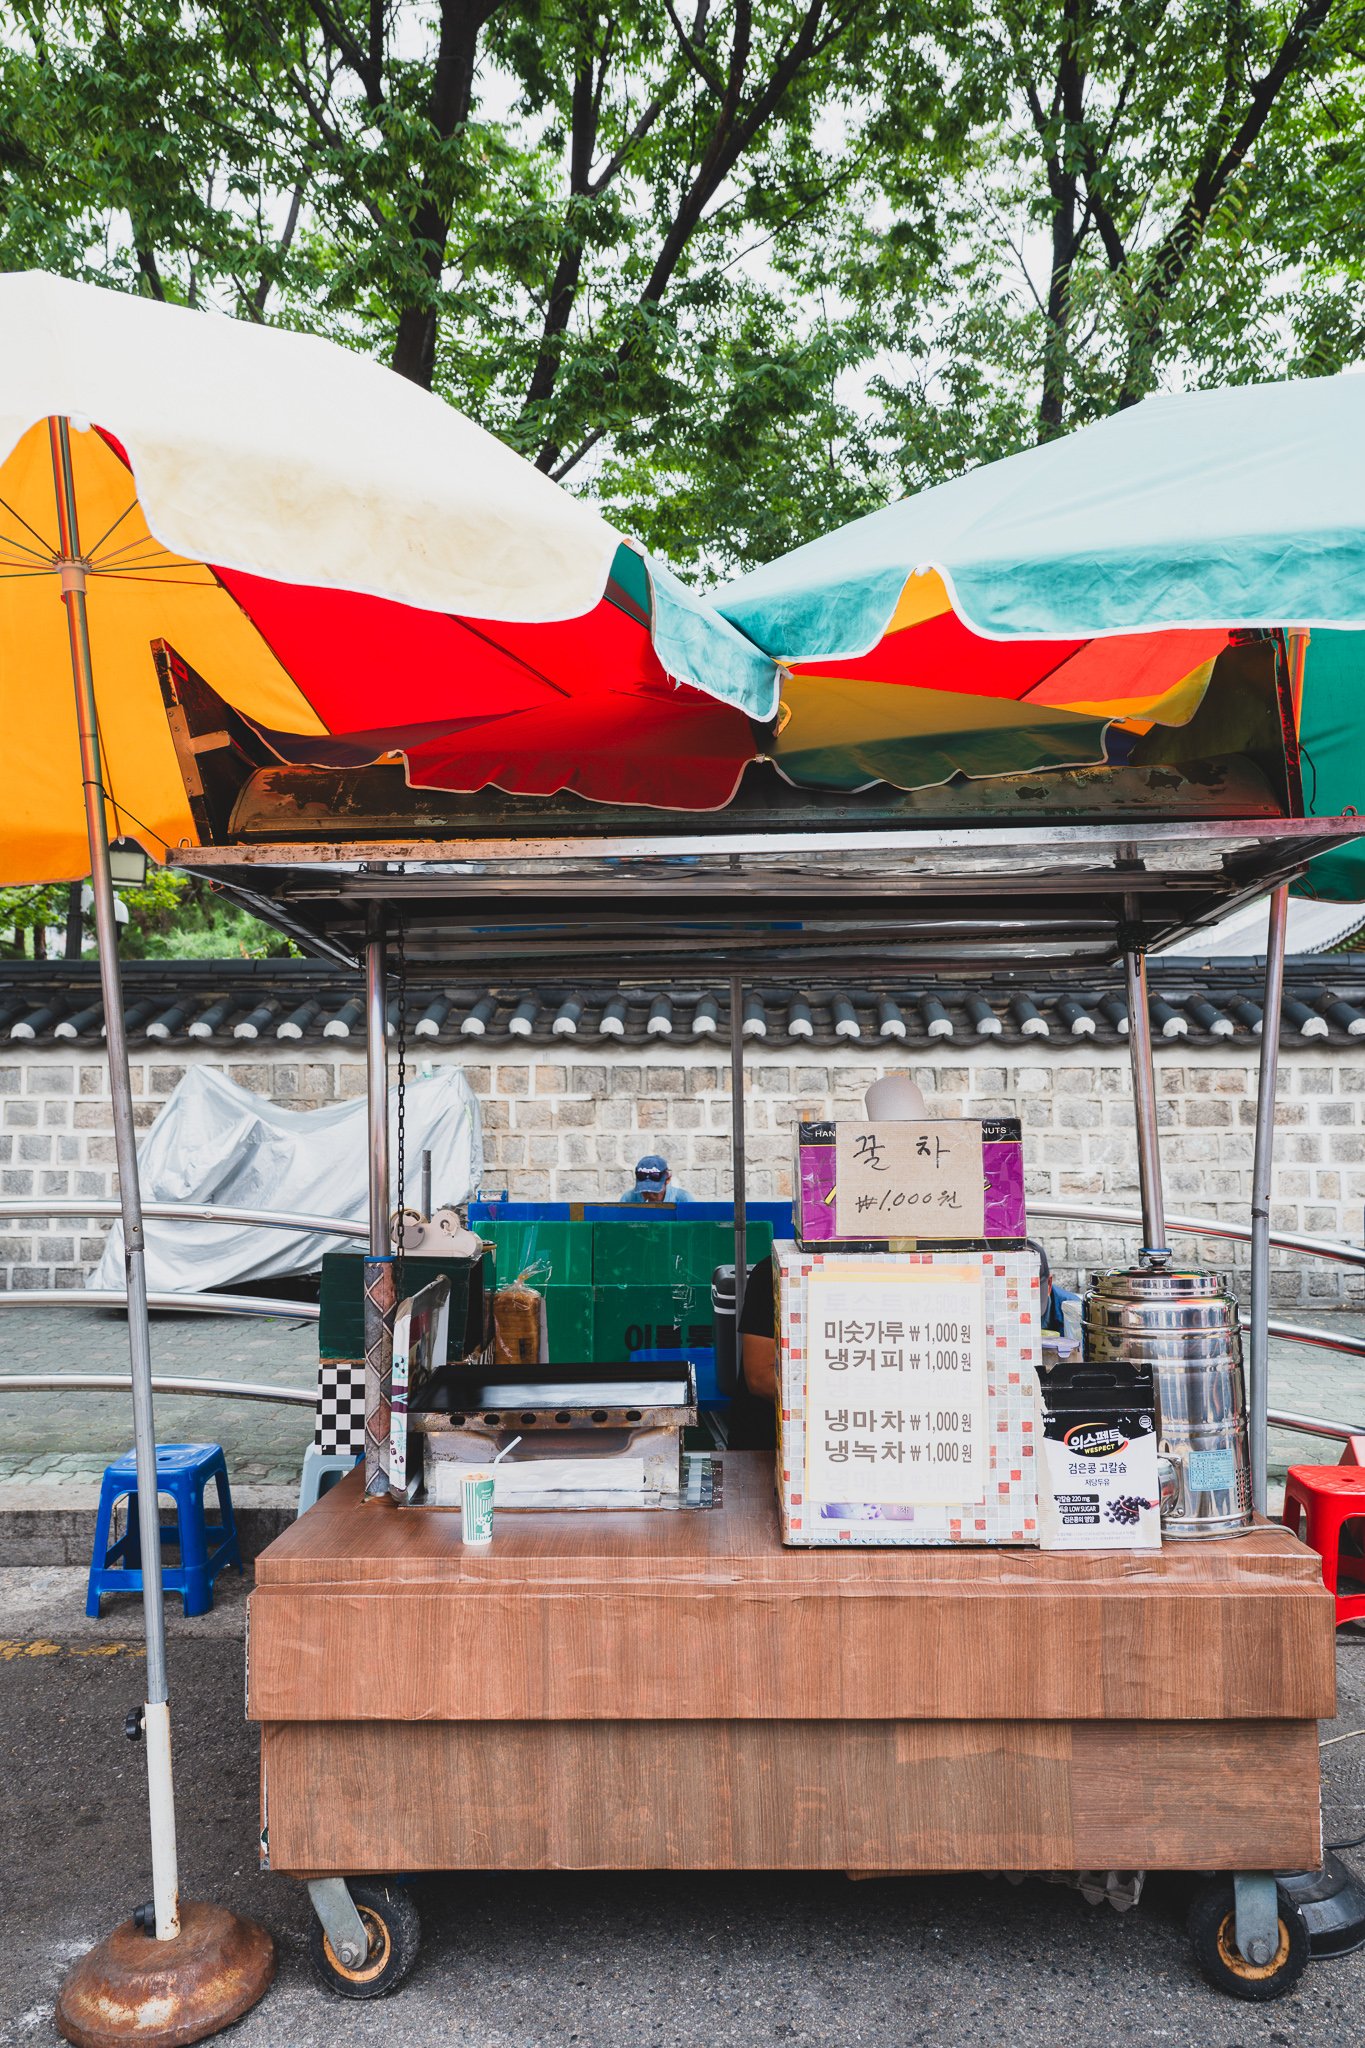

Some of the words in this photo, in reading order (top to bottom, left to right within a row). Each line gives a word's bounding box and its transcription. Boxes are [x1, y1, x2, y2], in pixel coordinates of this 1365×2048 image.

[824, 1319, 905, 1345] 미숫가루
[824, 1347, 904, 1372] 냉커피
[824, 1409, 906, 1433] 냉마차
[1069, 1428, 1124, 1450] 위스펙트
[1084, 1443, 1116, 1455] WESPECT
[824, 1439, 906, 1464] 냉녹차
[1068, 1462, 1096, 1475] 검은콩
[1099, 1462, 1127, 1474] 고칼슘
[1069, 1505, 1080, 1513] LOW
[1080, 1505, 1097, 1513] SUGAR
[1071, 1495, 1081, 1503] 220
